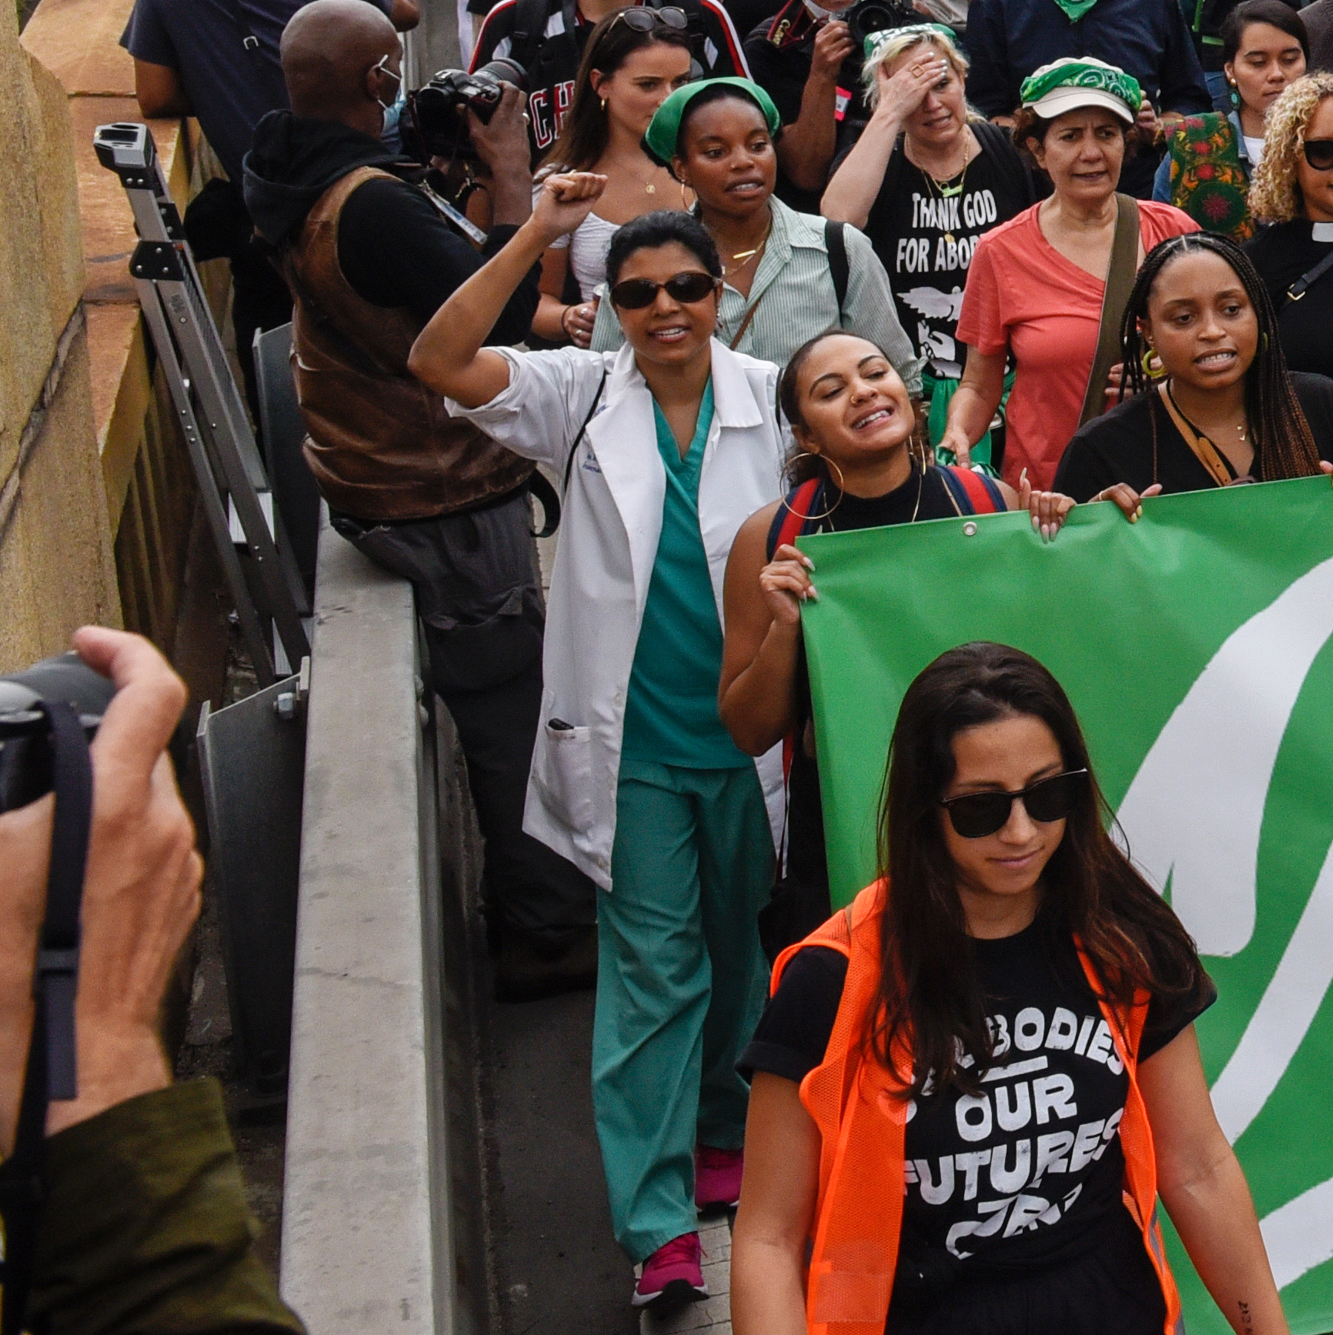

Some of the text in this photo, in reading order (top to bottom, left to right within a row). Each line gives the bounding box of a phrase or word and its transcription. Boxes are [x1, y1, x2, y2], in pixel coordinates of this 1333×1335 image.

[963, 191, 997, 227] GOD
[897, 238, 930, 274] FOR
[991, 1007, 1126, 1076] BODIES
[955, 1075, 1078, 1142] OUR
